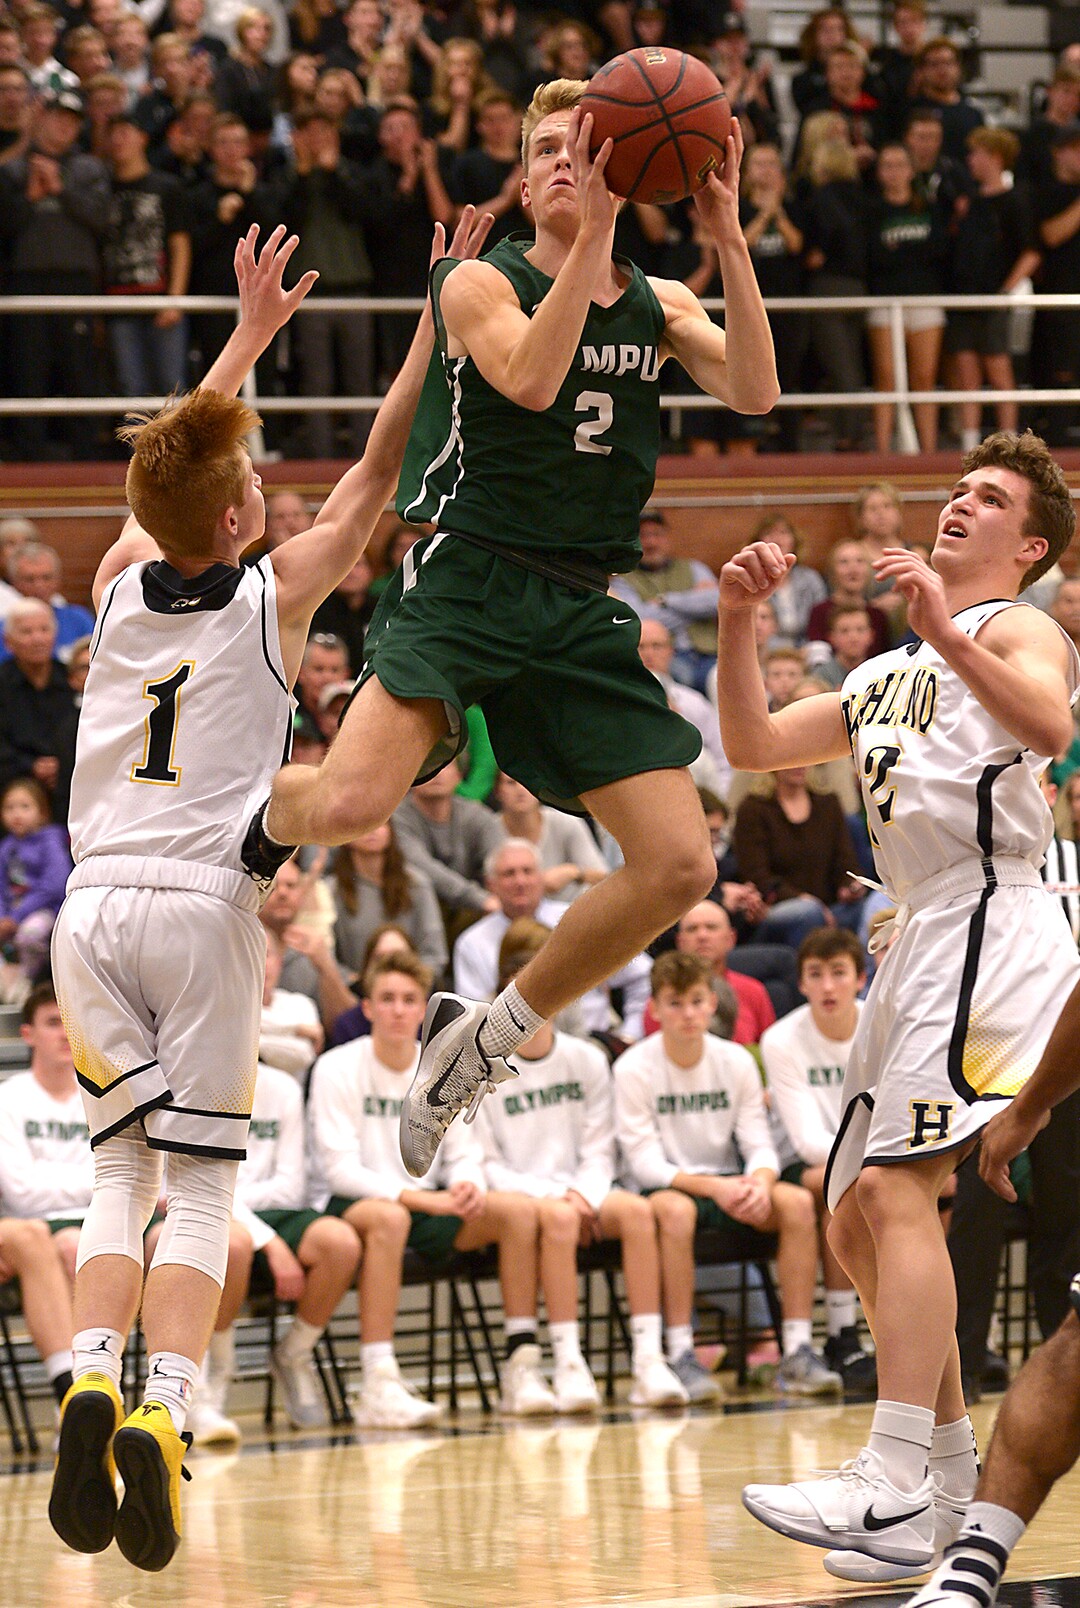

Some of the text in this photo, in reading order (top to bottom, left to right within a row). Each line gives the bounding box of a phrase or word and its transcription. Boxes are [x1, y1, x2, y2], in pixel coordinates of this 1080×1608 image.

[573, 390, 614, 457] 2
[130, 659, 197, 787] 1
[907, 1099, 957, 1150] H
